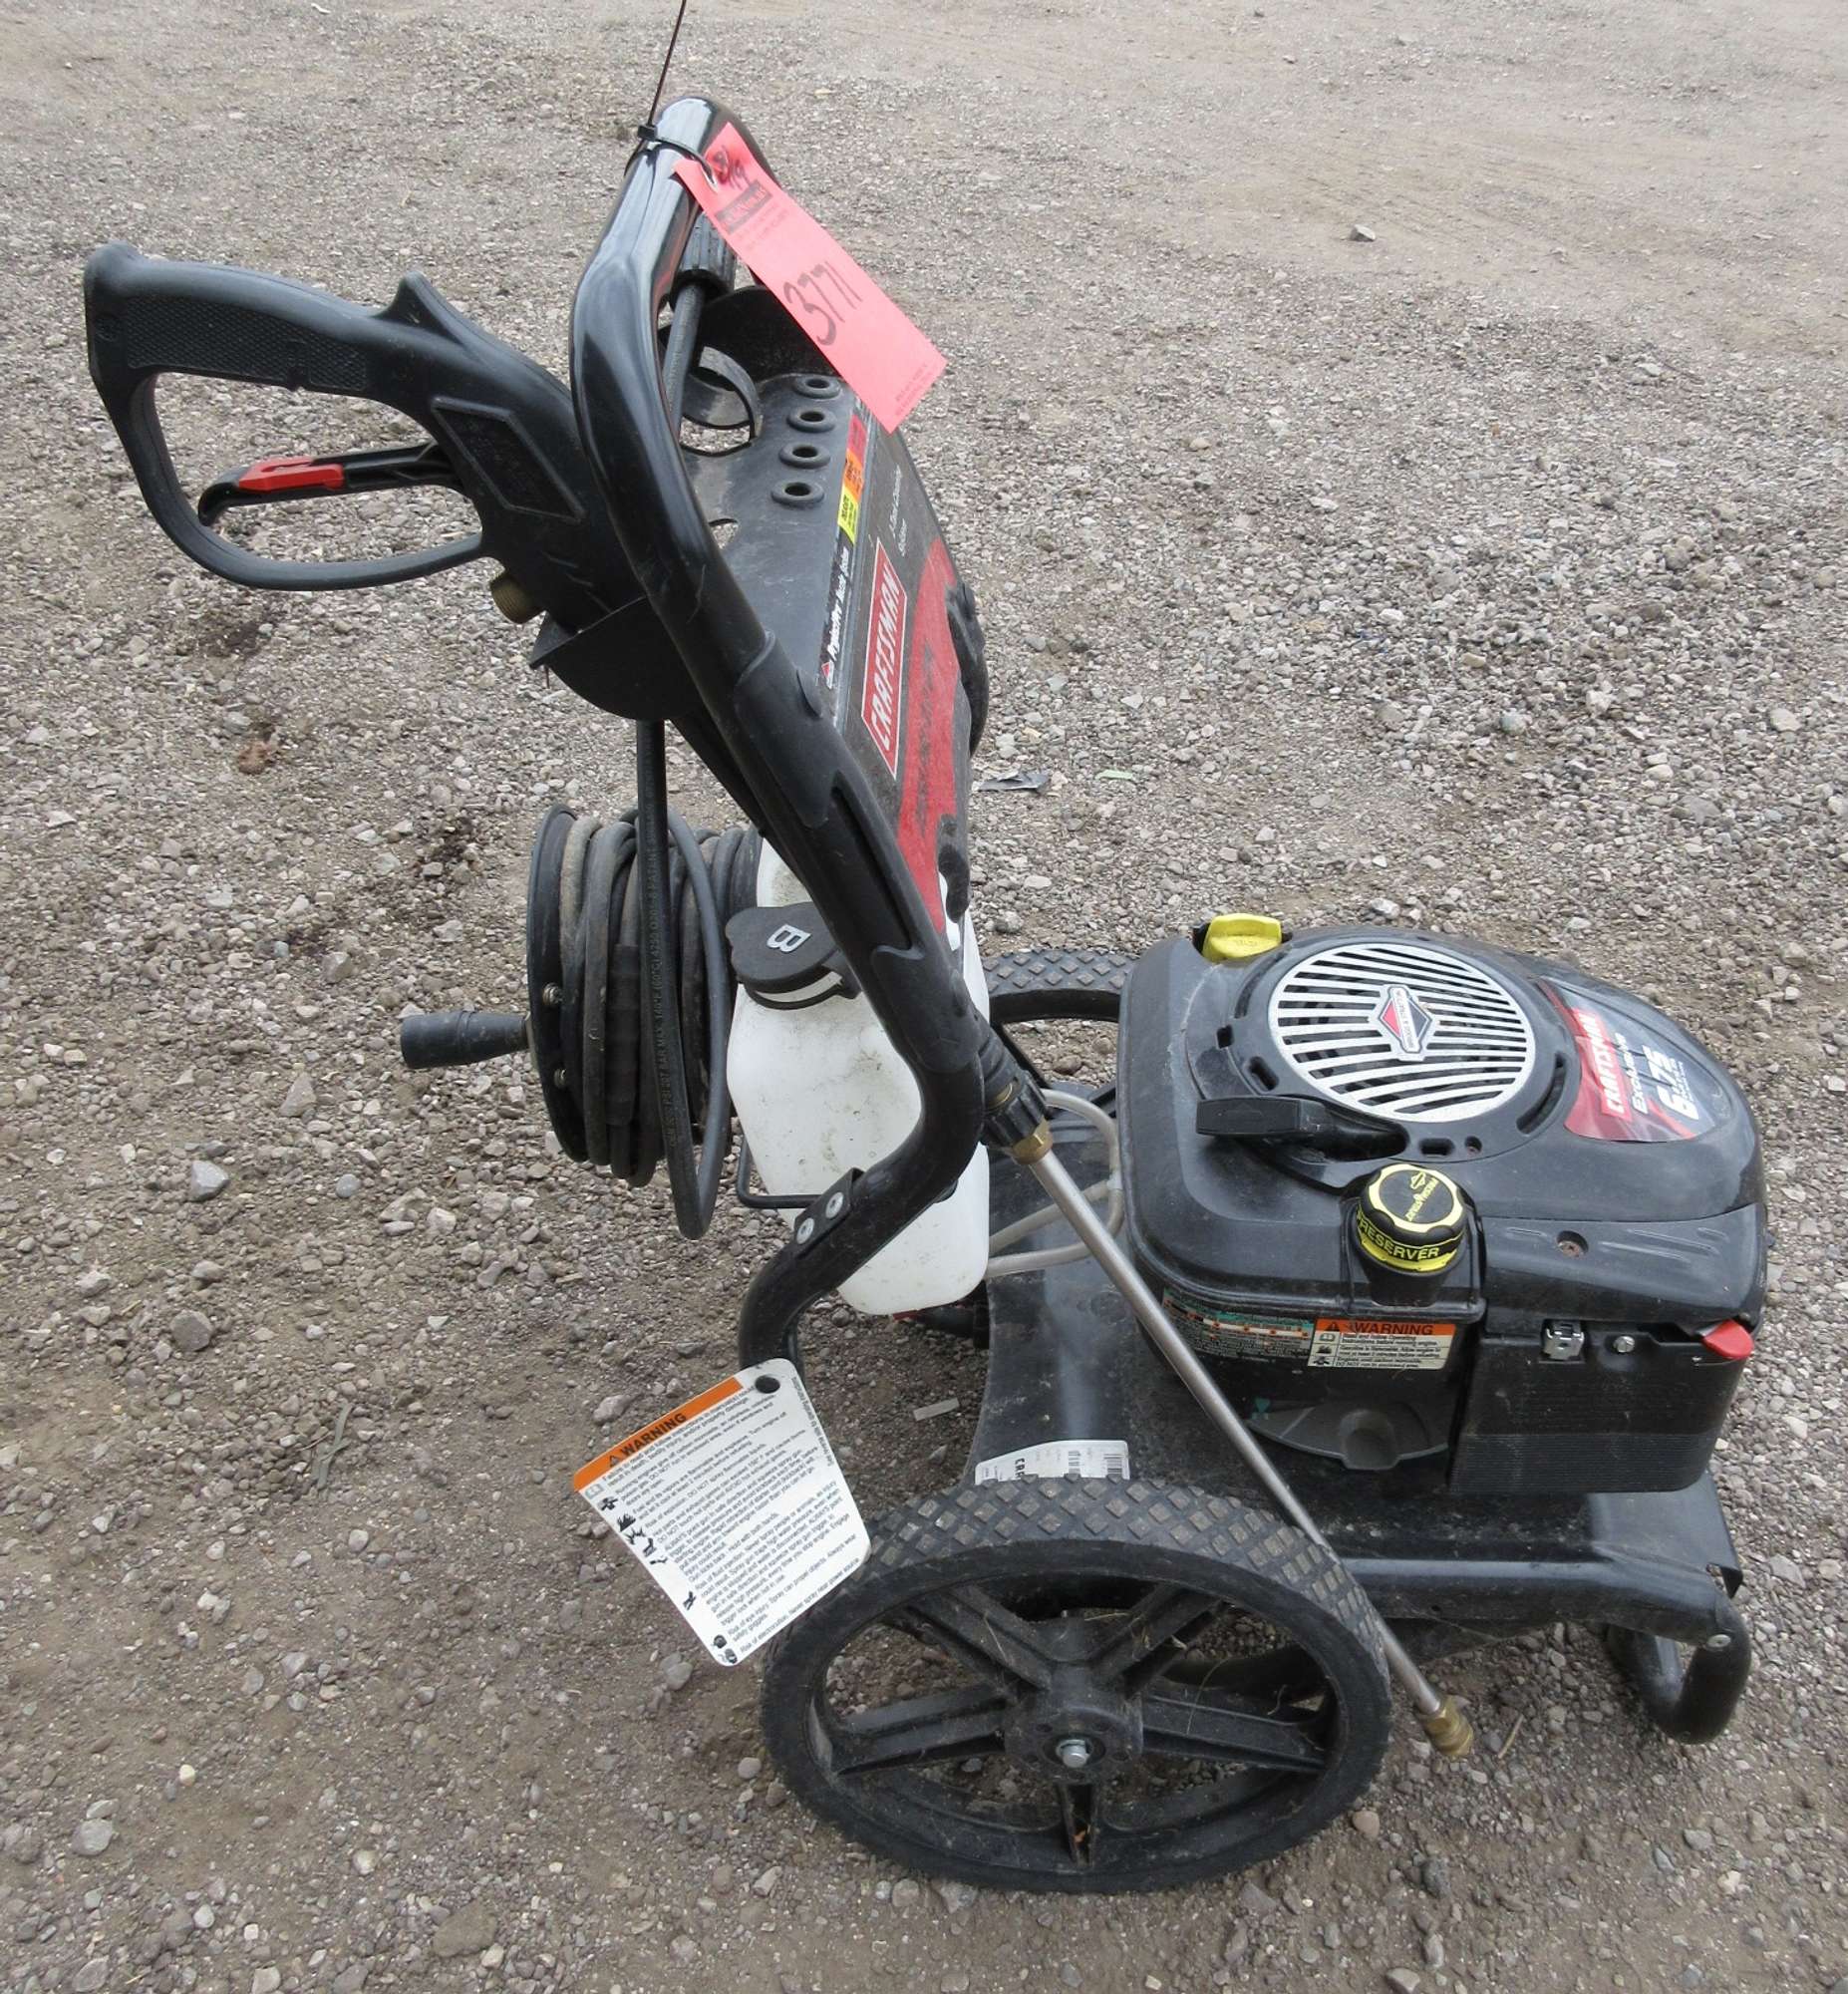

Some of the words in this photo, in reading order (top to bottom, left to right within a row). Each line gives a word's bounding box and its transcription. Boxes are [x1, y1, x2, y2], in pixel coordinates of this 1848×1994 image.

[782, 260, 864, 346] 3771
[870, 561, 901, 751] CRAFTSMAN
[1578, 1013, 1626, 1114] CRAFTSMAN
[1615, 1032, 1649, 1115] Exclusive
[1351, 1322, 1433, 1336] WARNING
[620, 1413, 688, 1456] WARNING
